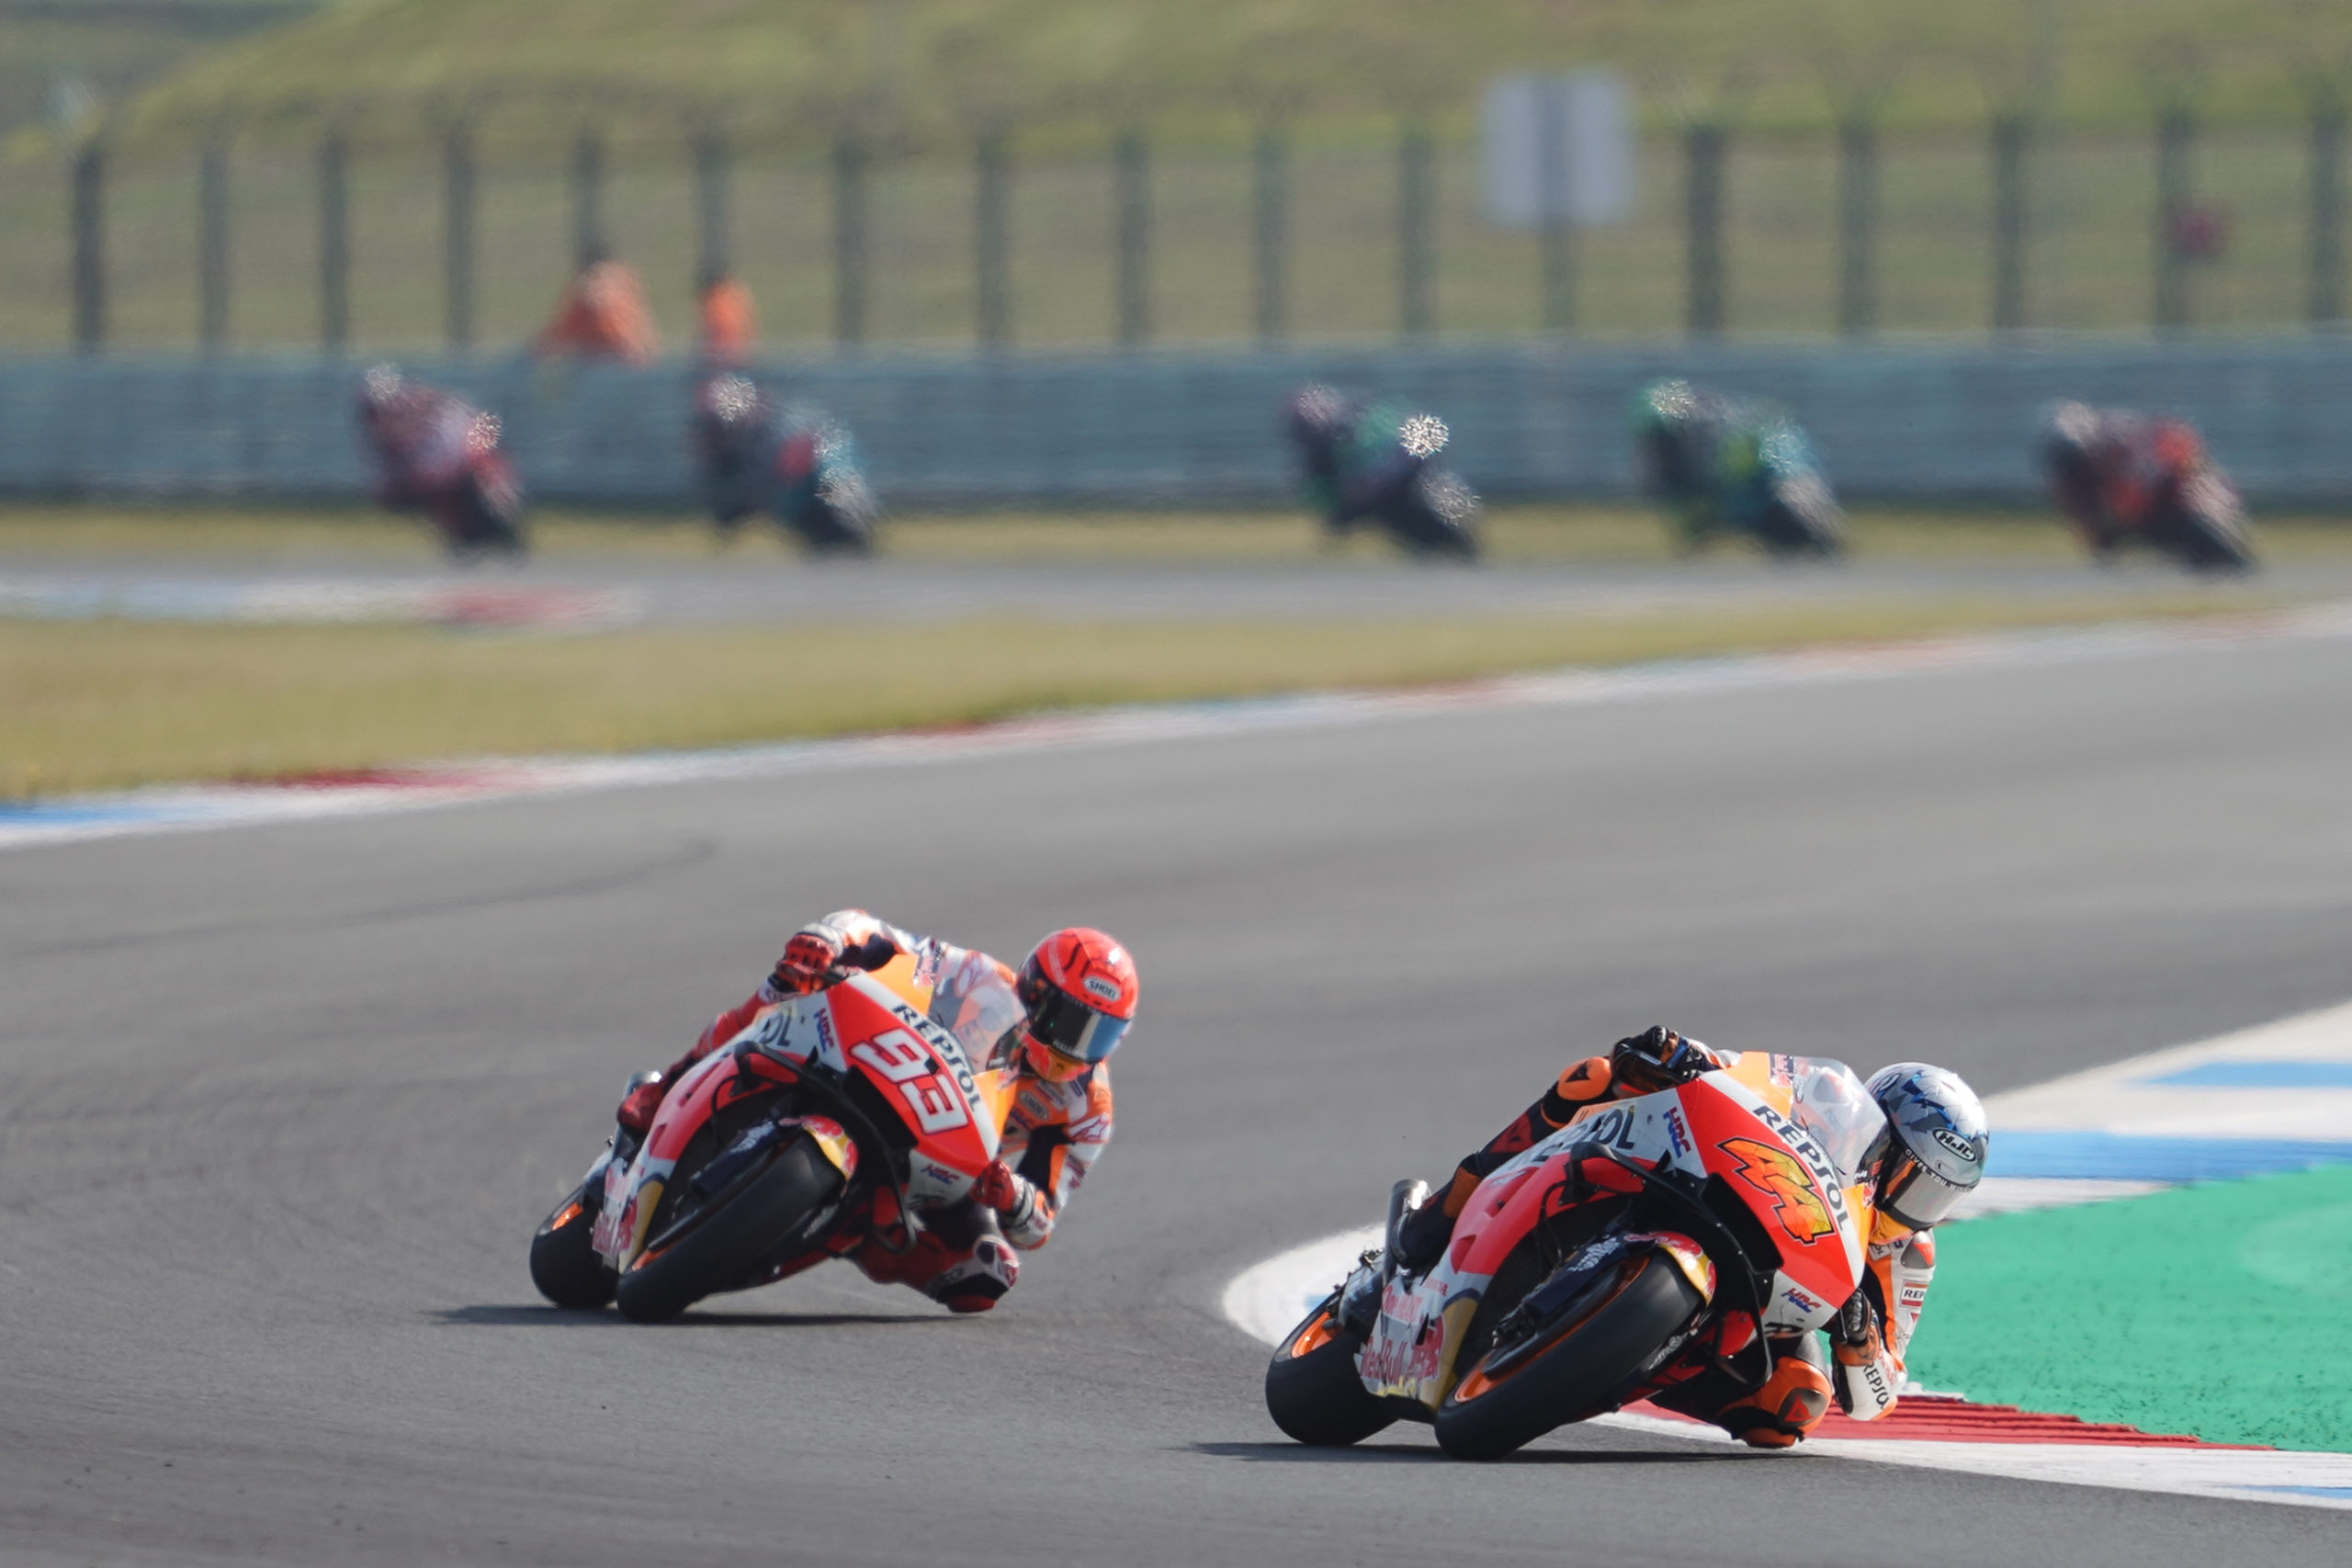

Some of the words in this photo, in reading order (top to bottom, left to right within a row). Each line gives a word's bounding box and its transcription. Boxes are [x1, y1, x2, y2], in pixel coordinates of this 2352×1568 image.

[849, 1027, 969, 1134] 93
[892, 1003, 981, 1112] REPSOL
[1663, 1107, 1690, 1158] HRC
[1753, 1105, 1849, 1231] REPSOL
[1939, 1131, 1975, 1160] HJC
[1715, 1136, 1835, 1245] 44
